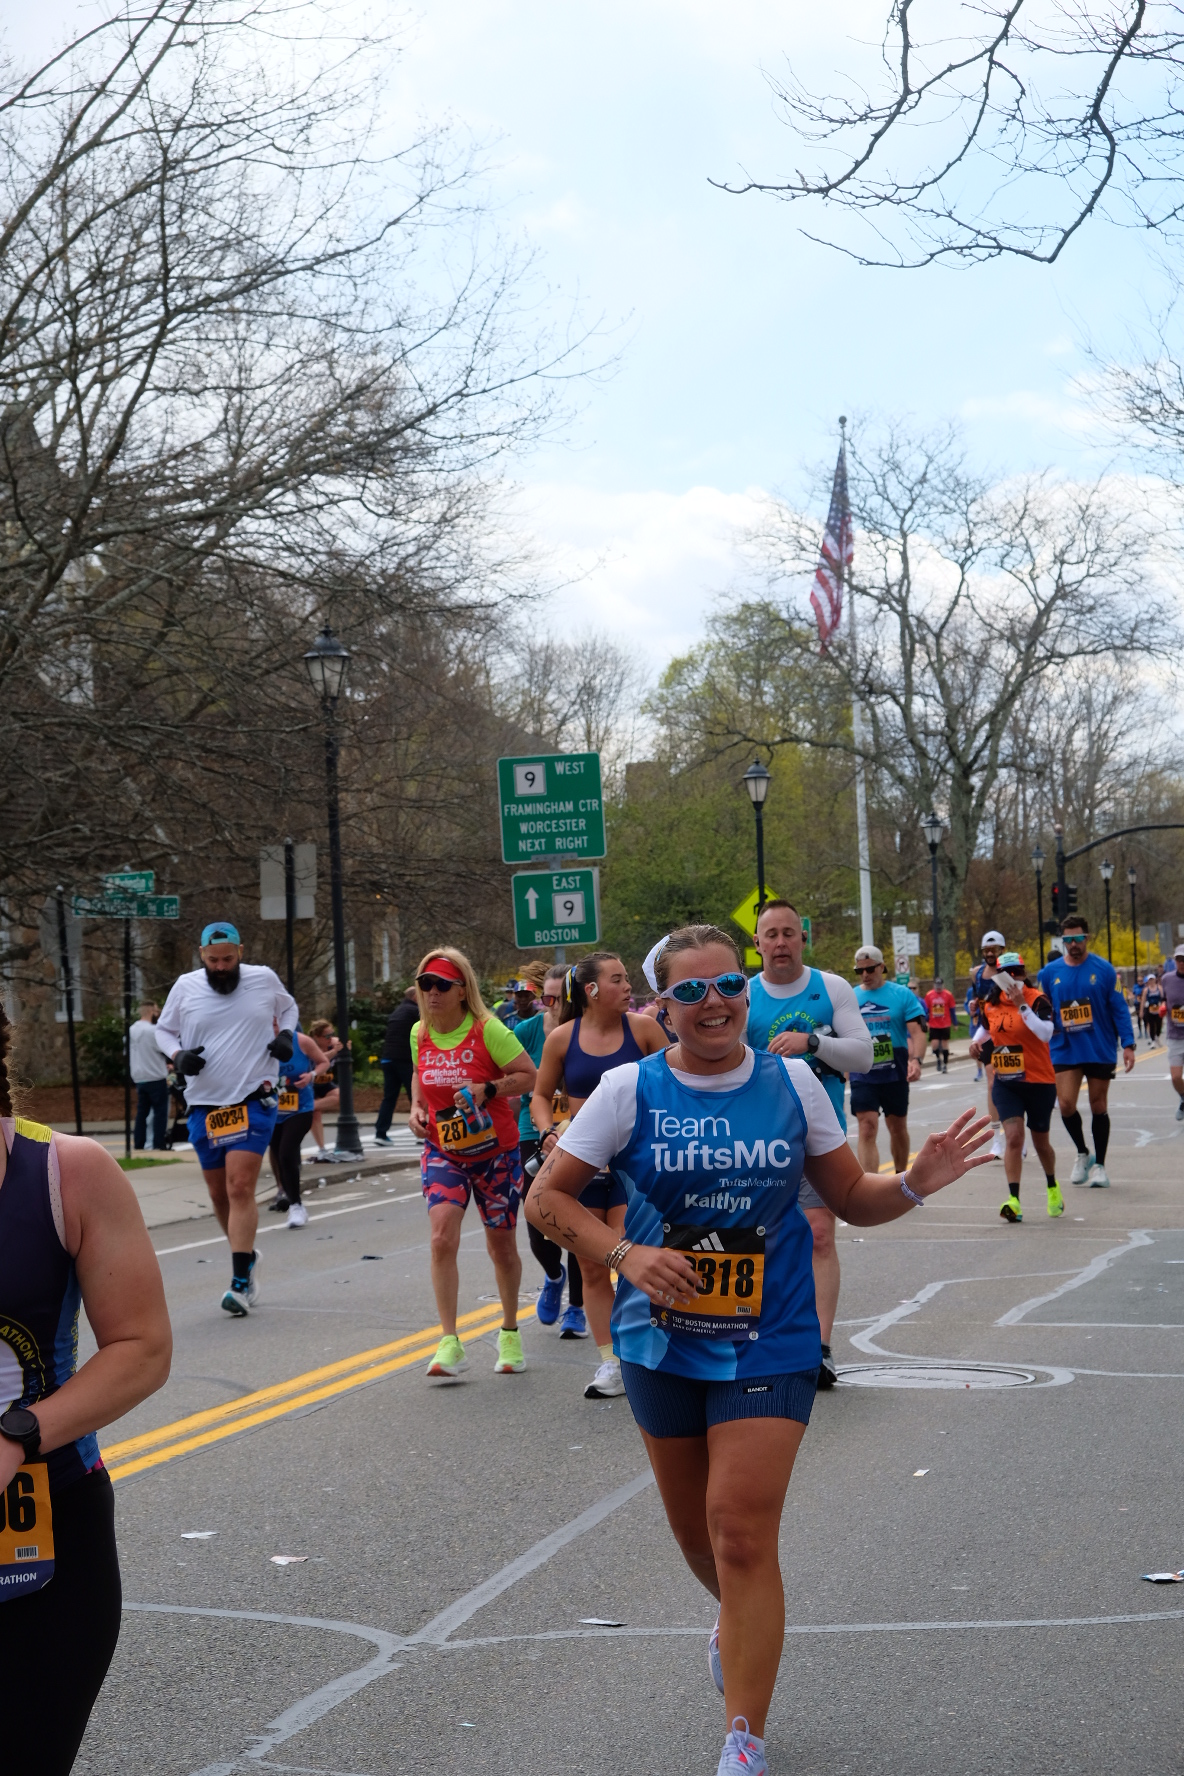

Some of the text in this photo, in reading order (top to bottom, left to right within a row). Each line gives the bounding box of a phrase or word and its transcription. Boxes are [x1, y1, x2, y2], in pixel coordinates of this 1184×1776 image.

[524, 761, 585, 788] 9 WEST
[504, 798, 600, 817] FRAMINGHAM CTR
[519, 818, 587, 834] WORCESTER
[518, 836, 588, 852] NEXT RIGHT
[552, 875, 581, 890] EAST
[563, 899, 575, 917] 9
[534, 928, 580, 943] BOSTON
[1063, 1007, 1090, 1021] 28010
[993, 1054, 1022, 1069] 31855
[430, 1068, 468, 1078] Michael's
[433, 1076, 463, 1085] Miracle
[208, 1107, 245, 1129] 30234
[649, 1109, 731, 1138] Team
[650, 1139, 792, 1172] TuftsMC
[685, 1192, 752, 1214] Kaitlyn
[685, 1319, 711, 1329] BOSTON
[712, 1321, 749, 1330] MARATHON
[693, 1327, 716, 1335] AMERICA
[0, 1472, 36, 1533] 6
